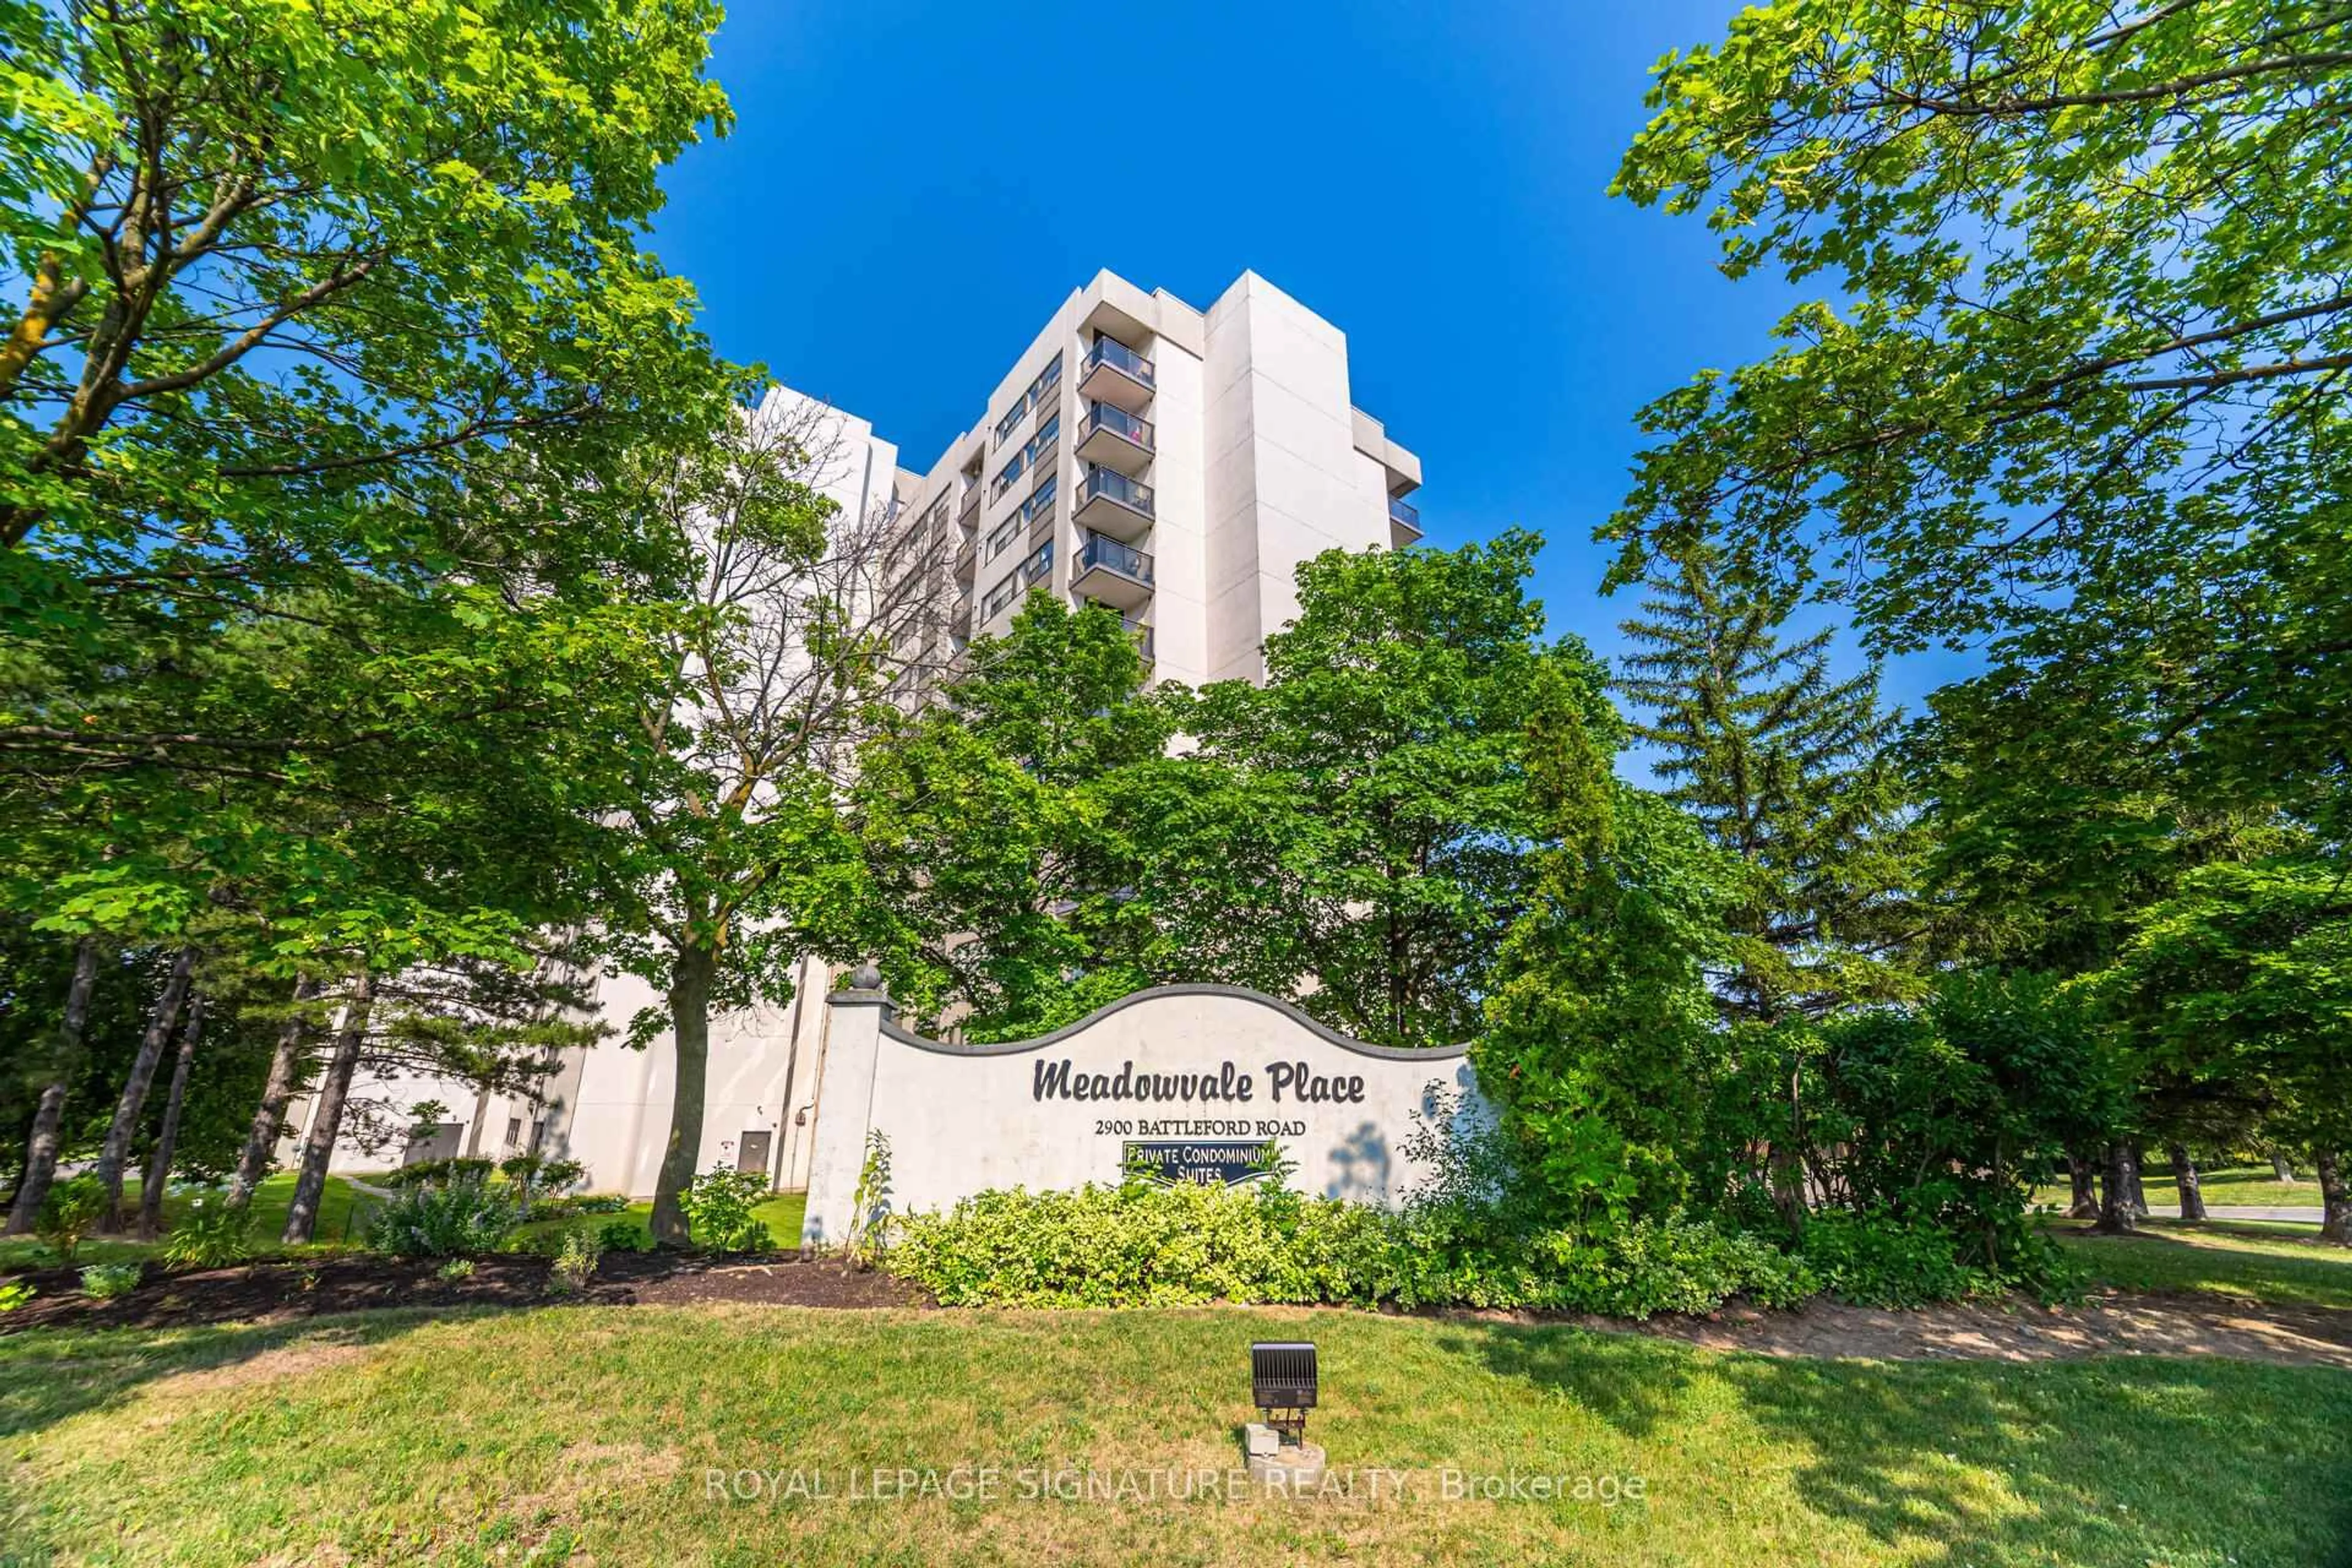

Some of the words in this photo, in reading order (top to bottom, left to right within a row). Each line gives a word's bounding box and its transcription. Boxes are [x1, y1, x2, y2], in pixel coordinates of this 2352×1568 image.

[1033, 1059, 1253, 1102] Meadowvale
[1266, 1061, 1365, 1103] Place
[1095, 1120, 1132, 1136] 2900
[1139, 1120, 1251, 1136] BATTLEFORD
[1257, 1120, 1306, 1136] ROAD
[1177, 1165, 1221, 1183] SUITES
